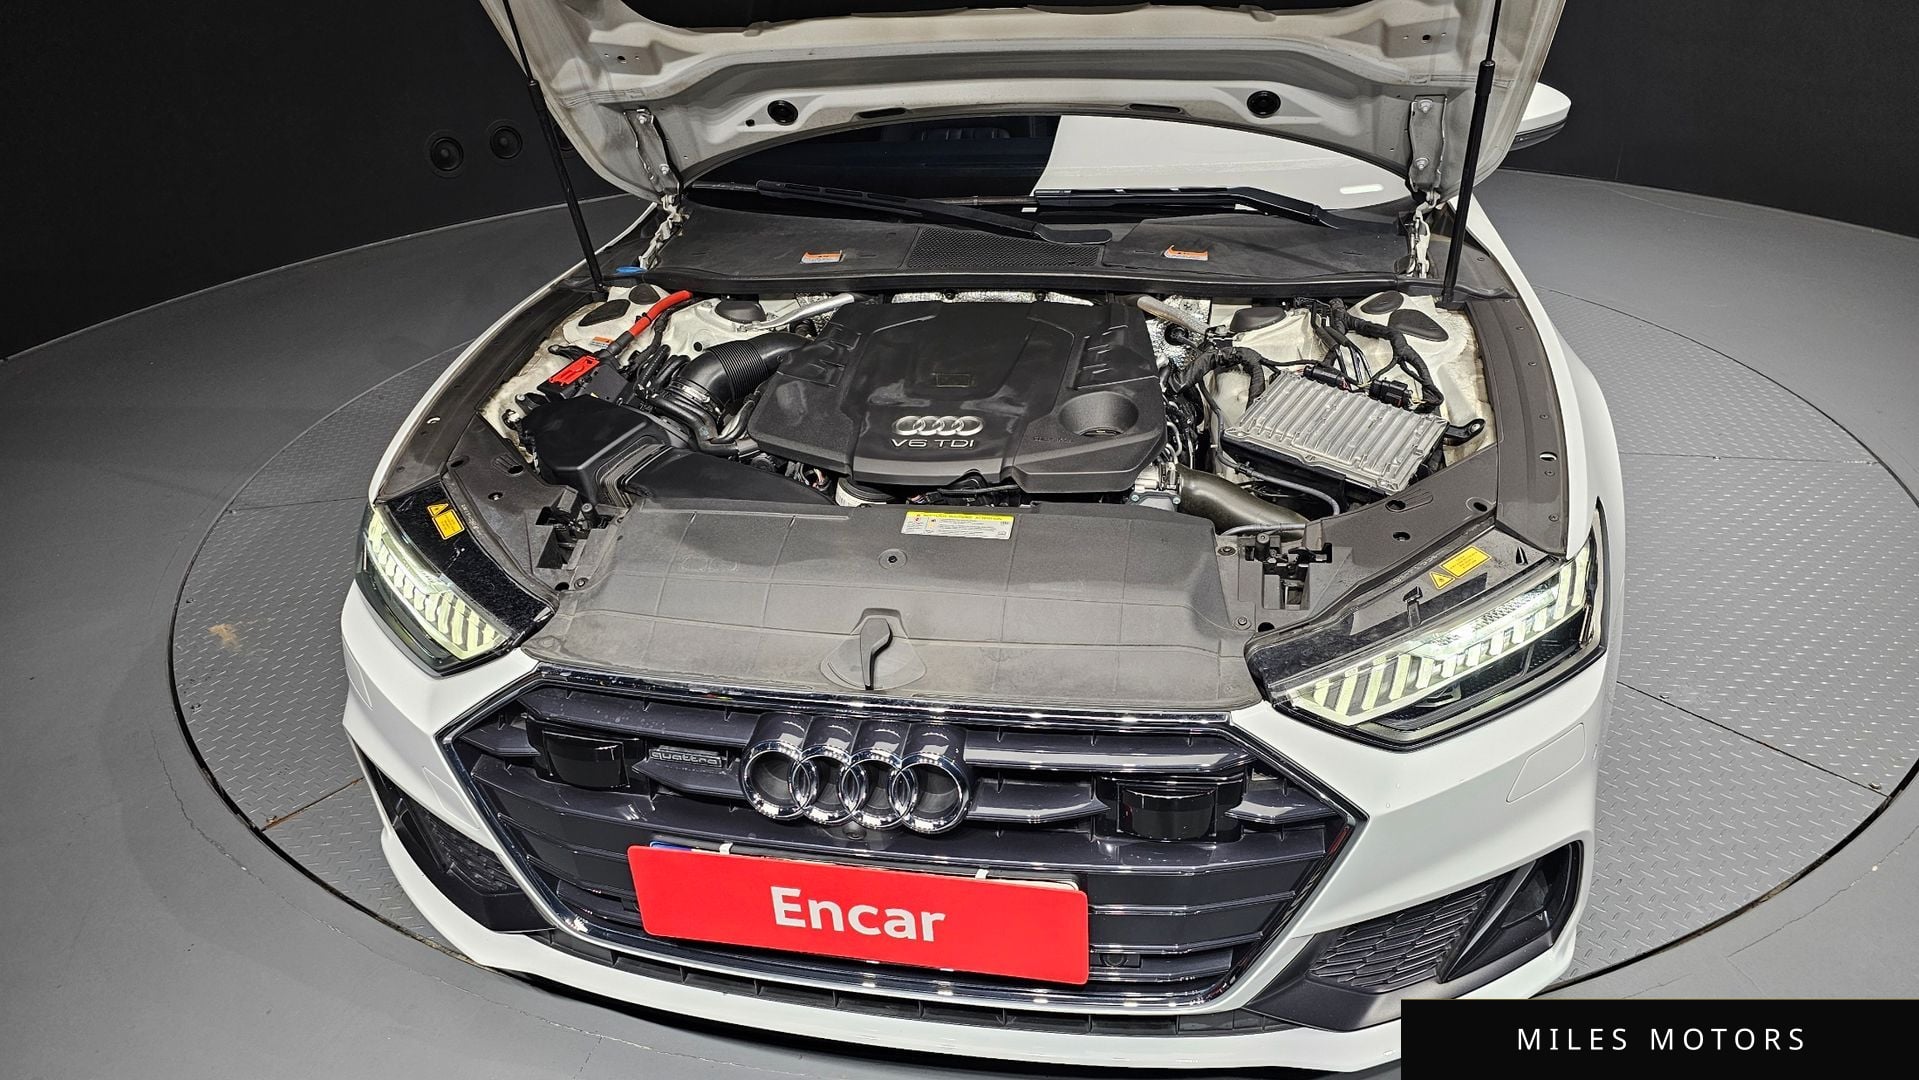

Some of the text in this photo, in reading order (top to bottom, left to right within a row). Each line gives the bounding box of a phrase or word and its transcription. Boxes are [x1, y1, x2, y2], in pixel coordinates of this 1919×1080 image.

[891, 438, 975, 448] V6 TDI
[651, 751, 718, 765] quattro
[770, 885, 946, 942] Encar
